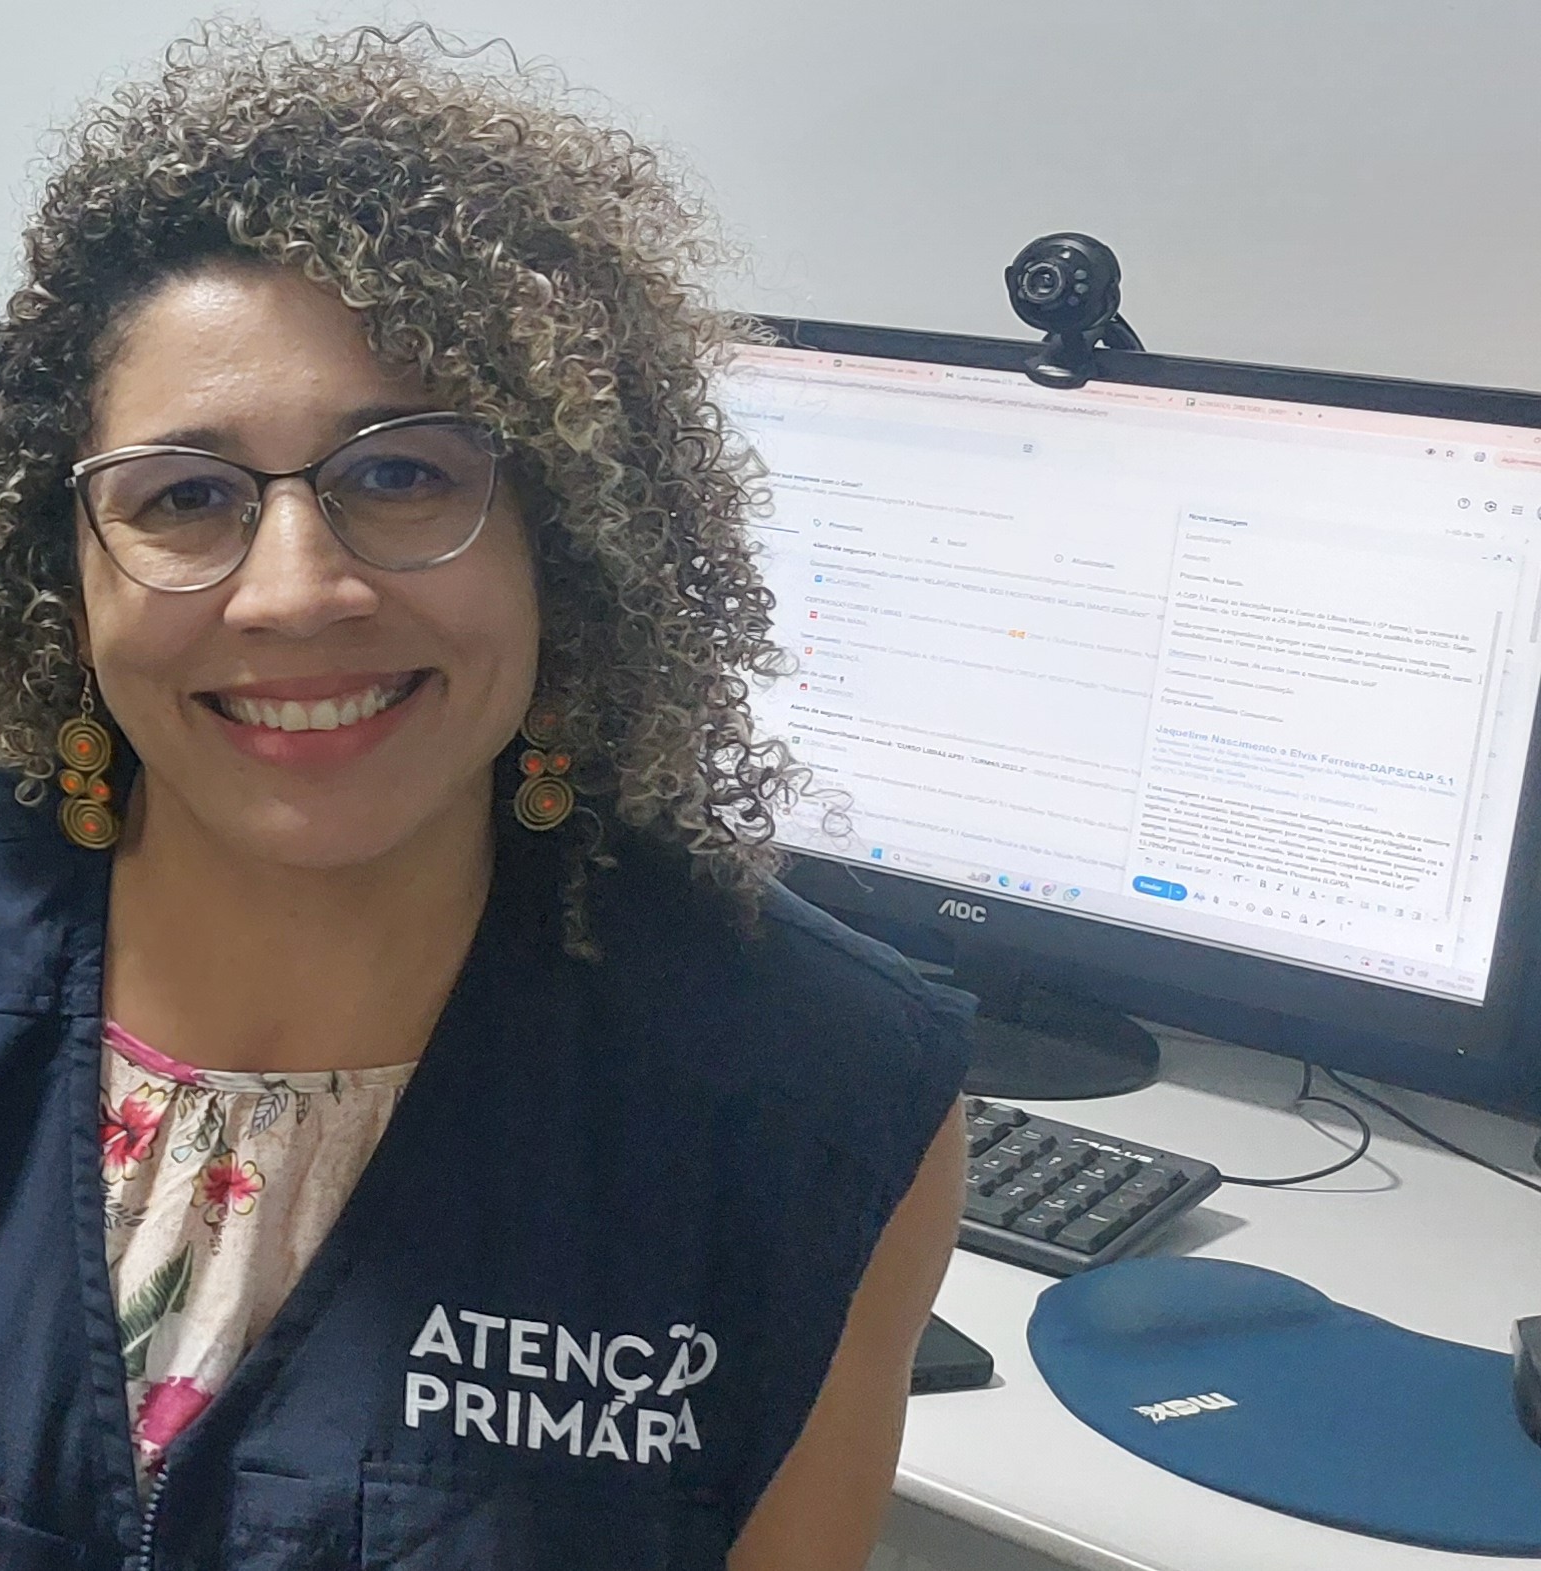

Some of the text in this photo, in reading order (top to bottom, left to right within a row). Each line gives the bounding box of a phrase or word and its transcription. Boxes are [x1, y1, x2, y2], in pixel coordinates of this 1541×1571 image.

[1154, 723, 1209, 743] Jaqueline
[1210, 733, 1278, 755] Nascimento
[1288, 747, 1318, 762] Elvis
[1320, 753, 1435, 783] Ferreira-DAPS/CAP
[938, 899, 987, 924] AOC
[409, 1303, 718, 1405] ATENÇÃO
[404, 1370, 702, 1465] PRIMÁRA
